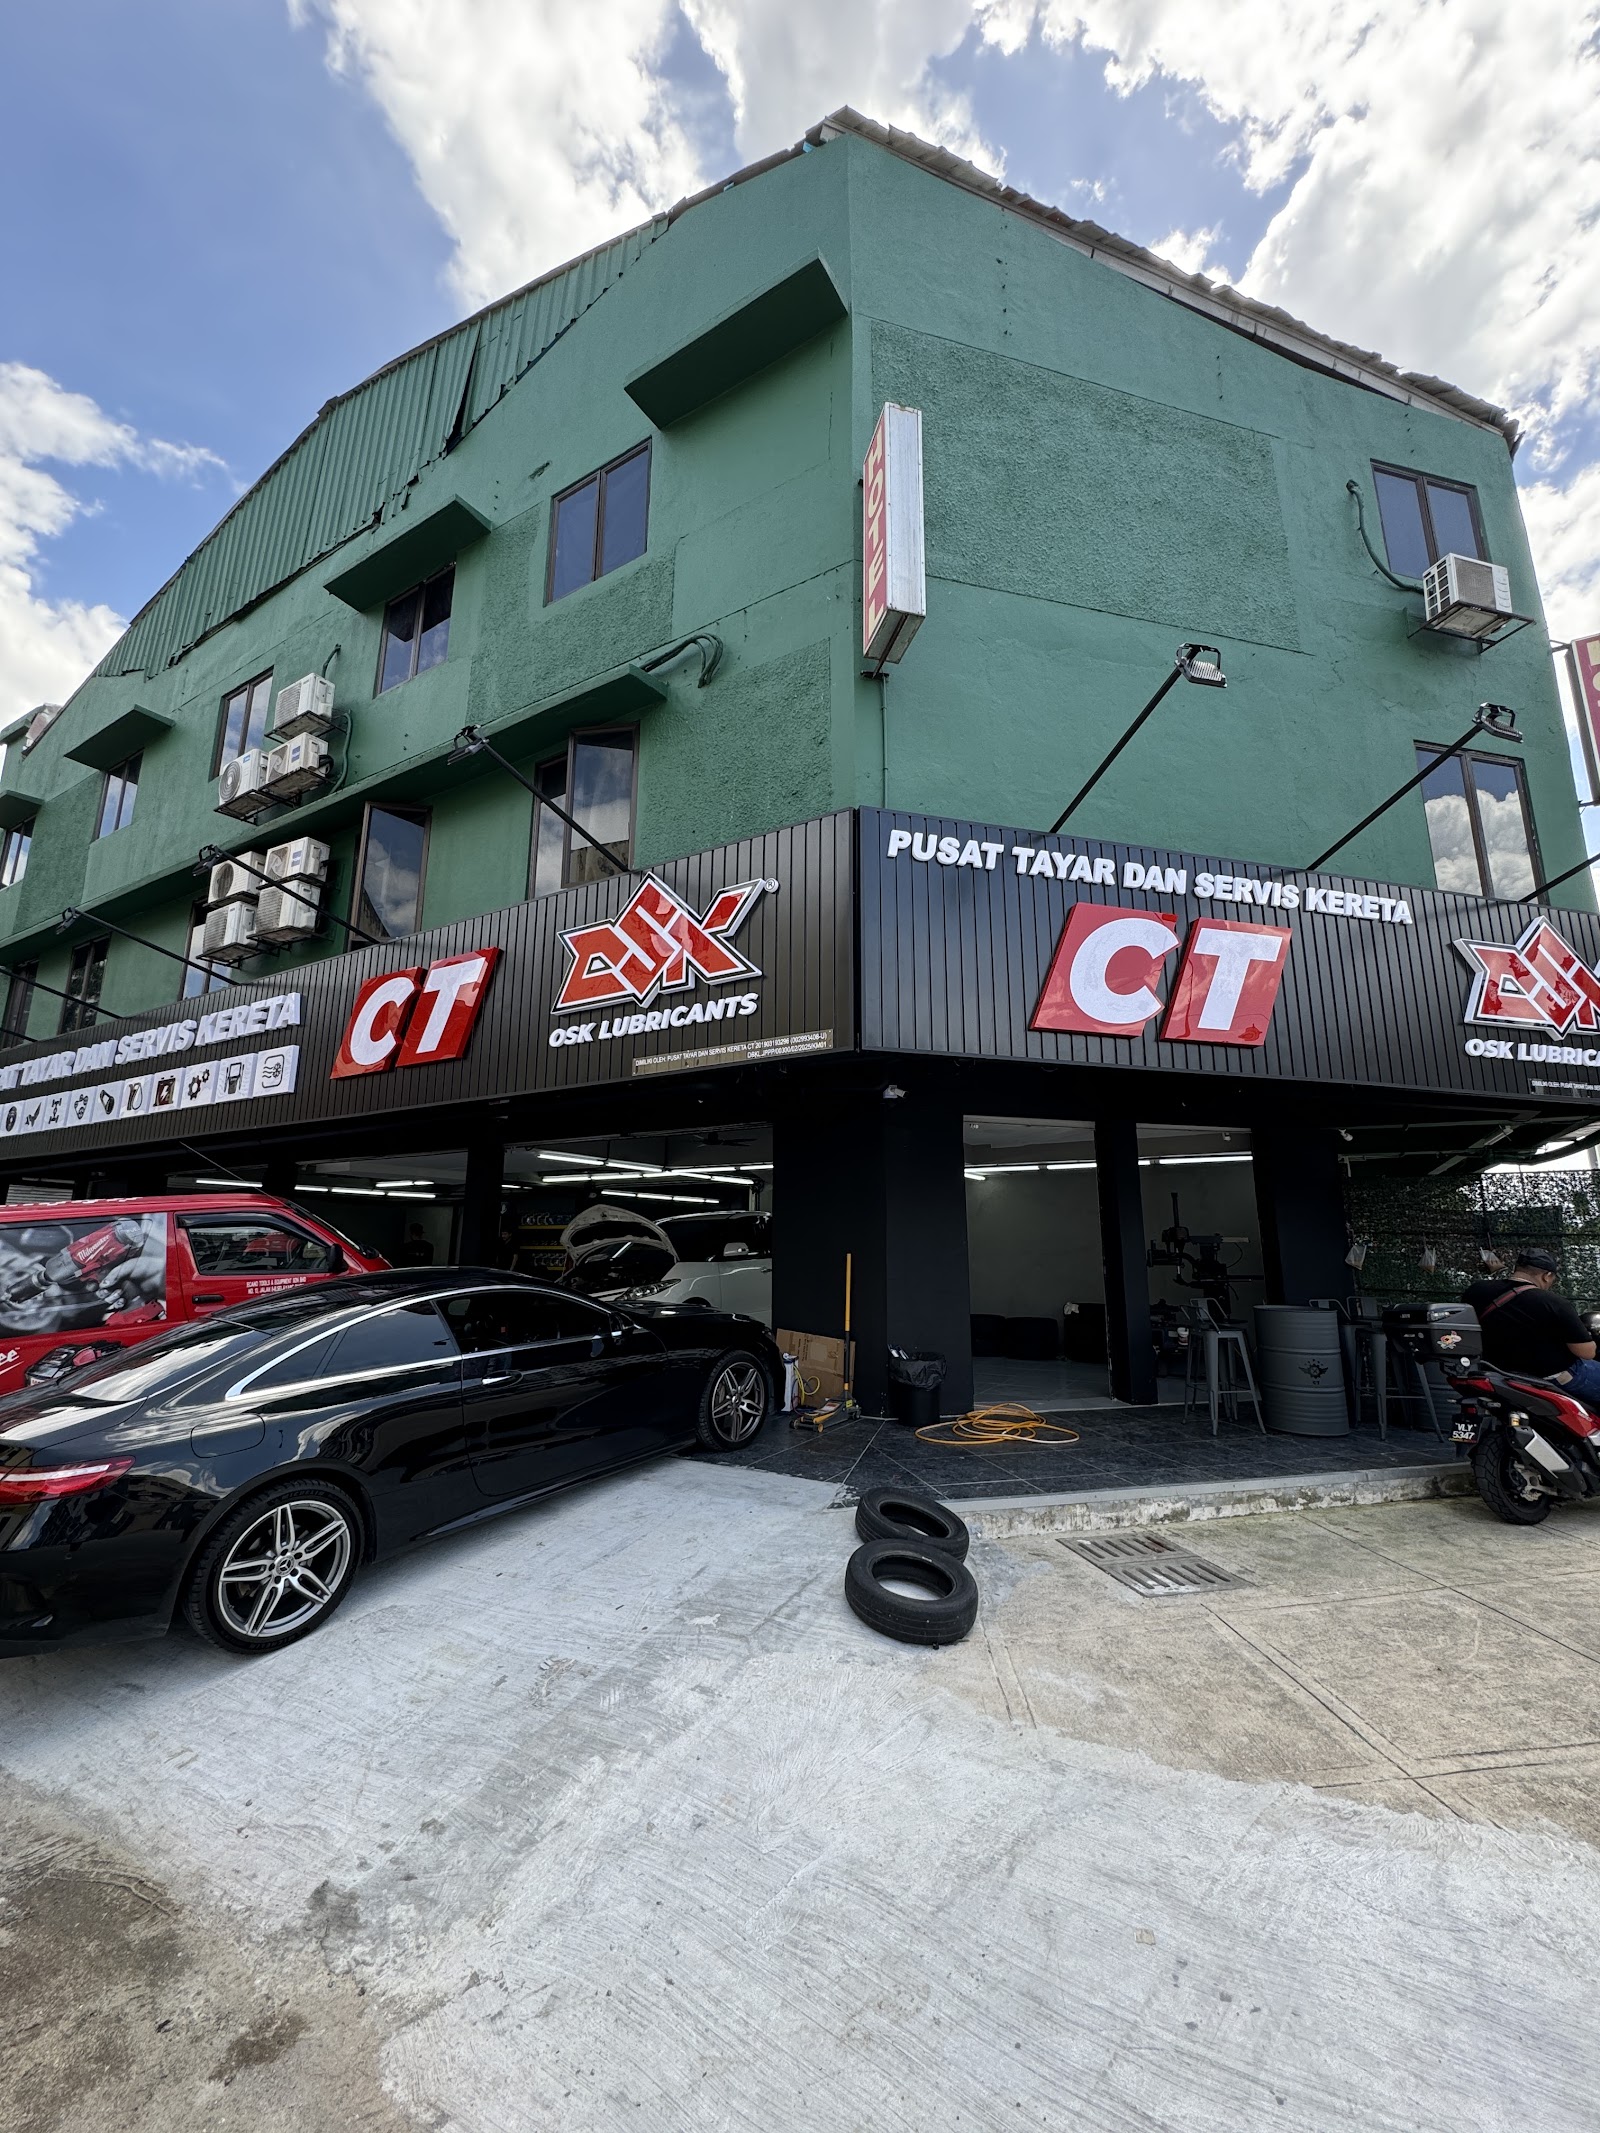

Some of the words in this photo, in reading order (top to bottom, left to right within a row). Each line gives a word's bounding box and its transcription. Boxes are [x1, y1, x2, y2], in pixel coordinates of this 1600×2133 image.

[868, 427, 884, 641] HOTEL
[887, 829, 1004, 870] PUSAT
[1011, 846, 1115, 886] TAYAR
[1123, 862, 1187, 895] DAN
[1194, 872, 1299, 909] SERVIS
[1305, 887, 1413, 925] KERETA
[1070, 918, 1282, 1030] CT
[20, 1051, 76, 1085] TAYAR
[72, 1040, 118, 1074] DAN
[115, 1019, 197, 1065] SERVIS
[195, 992, 300, 1046] KERETA
[351, 957, 486, 1066] CT
[549, 1022, 597, 1048] OSK
[599, 993, 758, 1040] LUBRICANTS
[667, 1053, 682, 1062] PUSAT
[683, 1051, 697, 1060] TAYAR
[698, 1049, 709, 1057] DAN
[708, 1047, 726, 1056] SERVIS
[726, 1044, 747, 1053] KERETA
[1465, 1038, 1514, 1060] OSK
[1452, 1430, 1475, 1440] 5347
[1457, 1423, 1473, 1431] VLY
